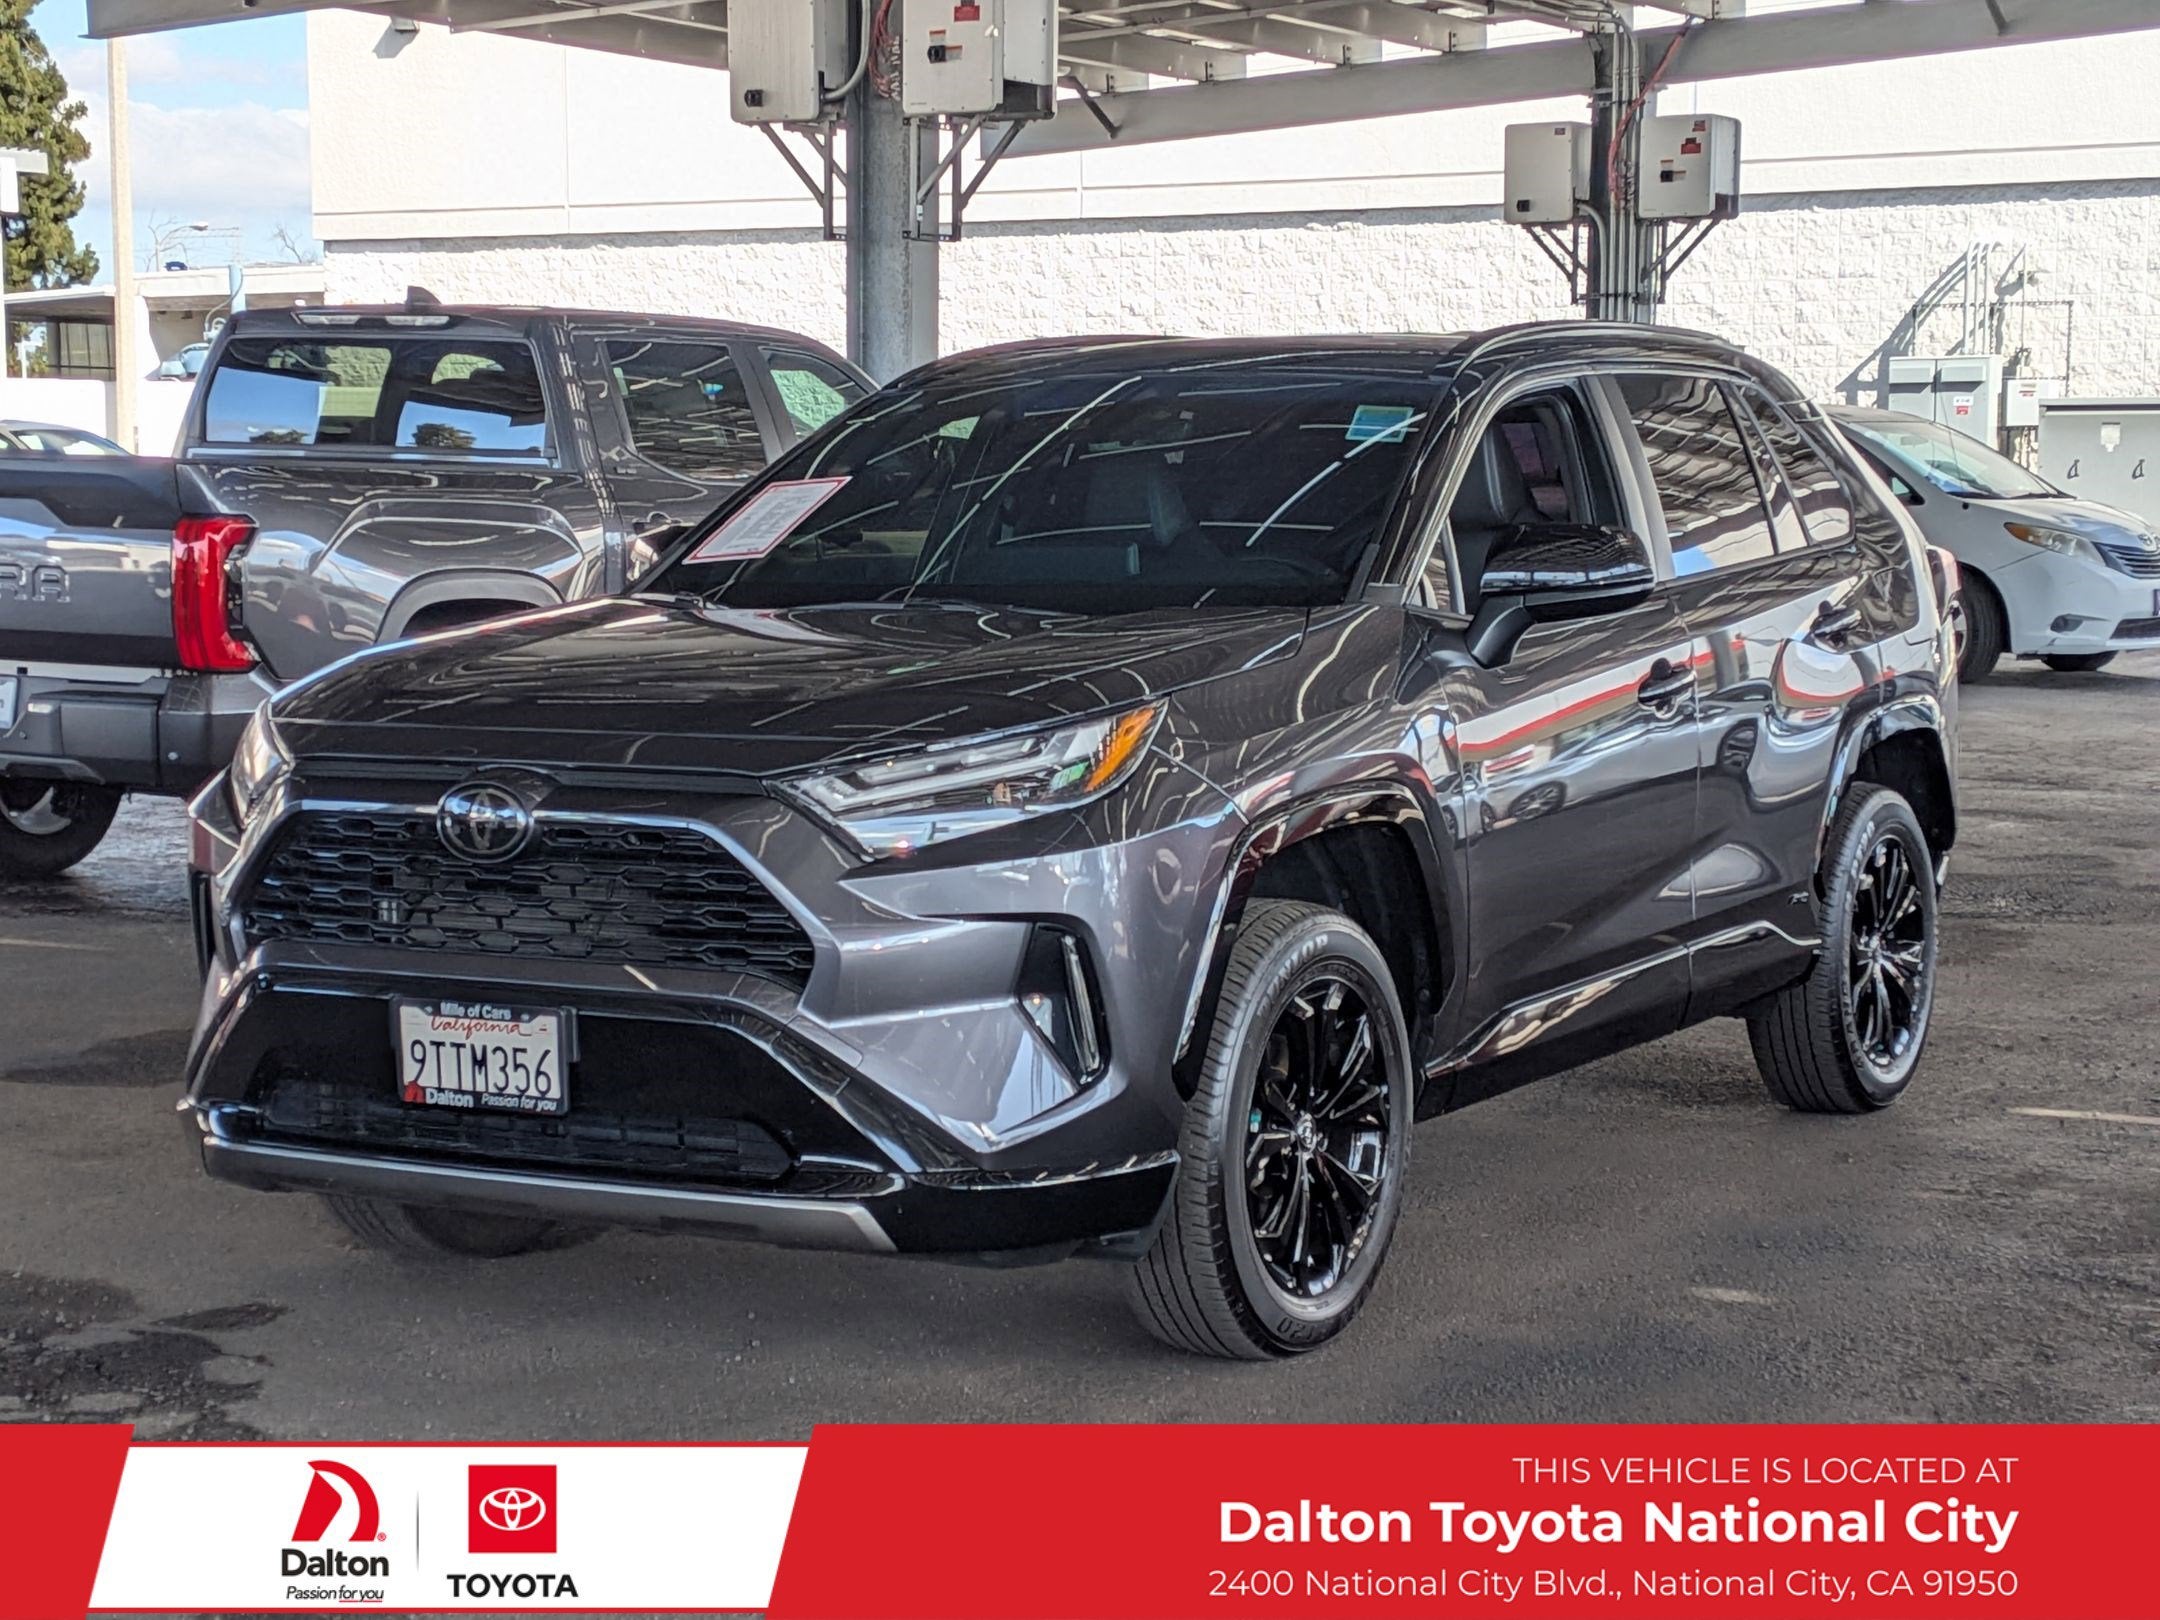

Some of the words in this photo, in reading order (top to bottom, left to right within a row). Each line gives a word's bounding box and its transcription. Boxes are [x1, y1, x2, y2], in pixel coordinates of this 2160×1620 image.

[440, 1001, 465, 1016] Mile
[467, 1003, 480, 1017] of
[481, 1005, 511, 1020] Cars
[431, 1016, 532, 1040] California
[410, 1038, 552, 1098] 9TTM356
[426, 1088, 474, 1107] Dalton
[481, 1094, 519, 1109] Passion
[520, 1097, 536, 1109] for
[537, 1100, 557, 1111] you
